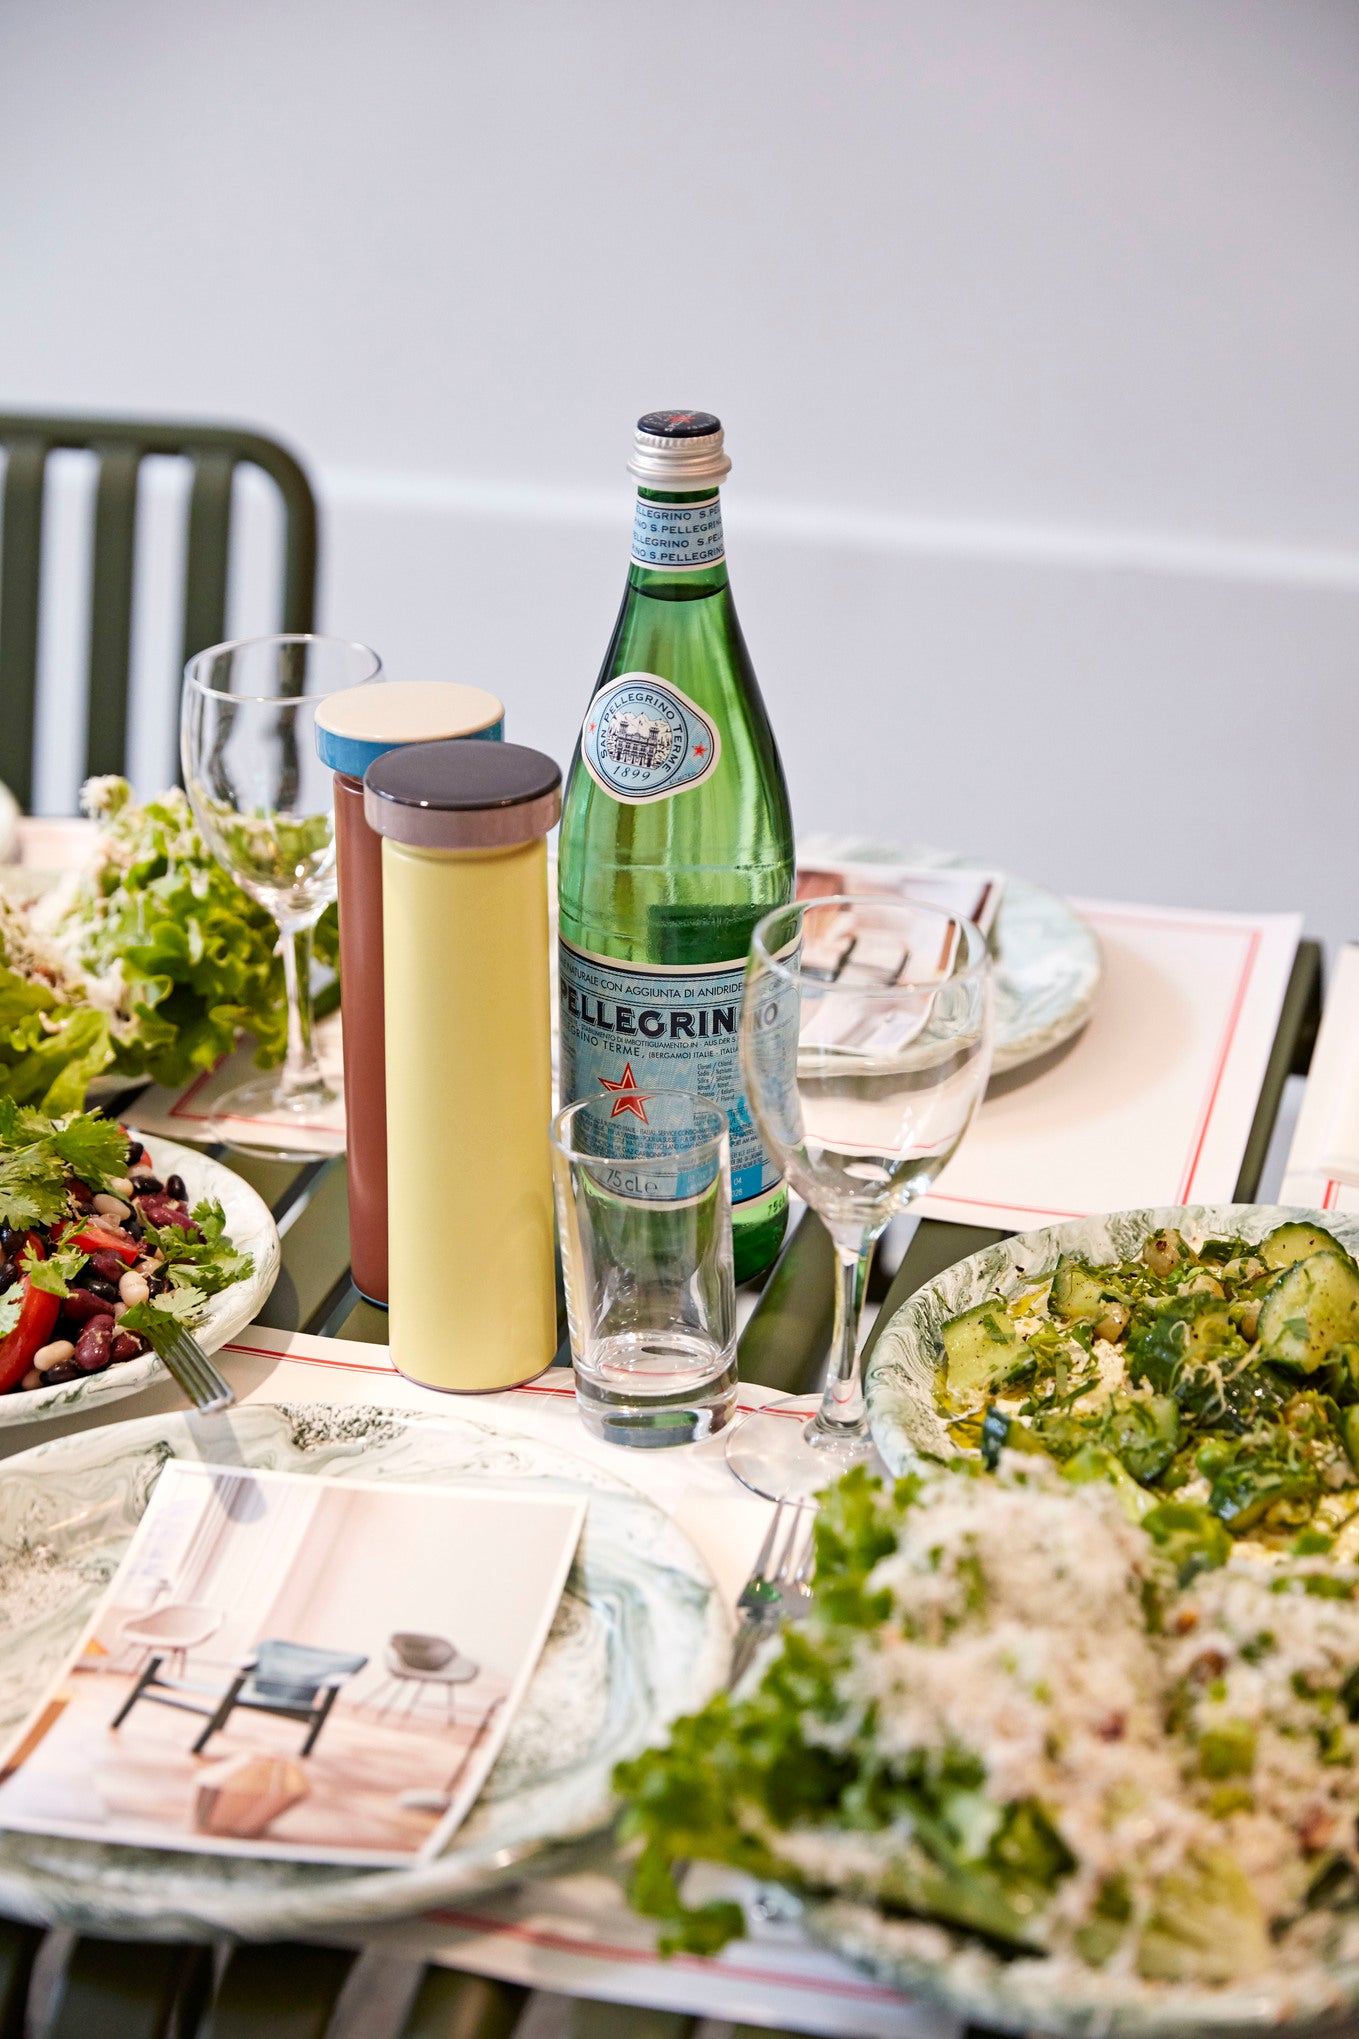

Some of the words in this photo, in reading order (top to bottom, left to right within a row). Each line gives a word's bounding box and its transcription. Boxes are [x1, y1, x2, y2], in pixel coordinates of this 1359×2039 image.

[604, 693, 675, 724] PELLEGRINO
[600, 729, 609, 759] SAN
[661, 724, 683, 773] TERME
[612, 765, 651, 781] 1899
[567, 963, 599, 987] NATURALE
[600, 979, 623, 993] CON
[625, 986, 681, 998] AGGIUNTA
[684, 988, 695, 998] DI
[697, 982, 744, 998] ANIDRIDE
[693, 1050, 714, 1060] ITALIE
[703, 1038, 718, 1047] AUS
[719, 1036, 731, 1046] DER
